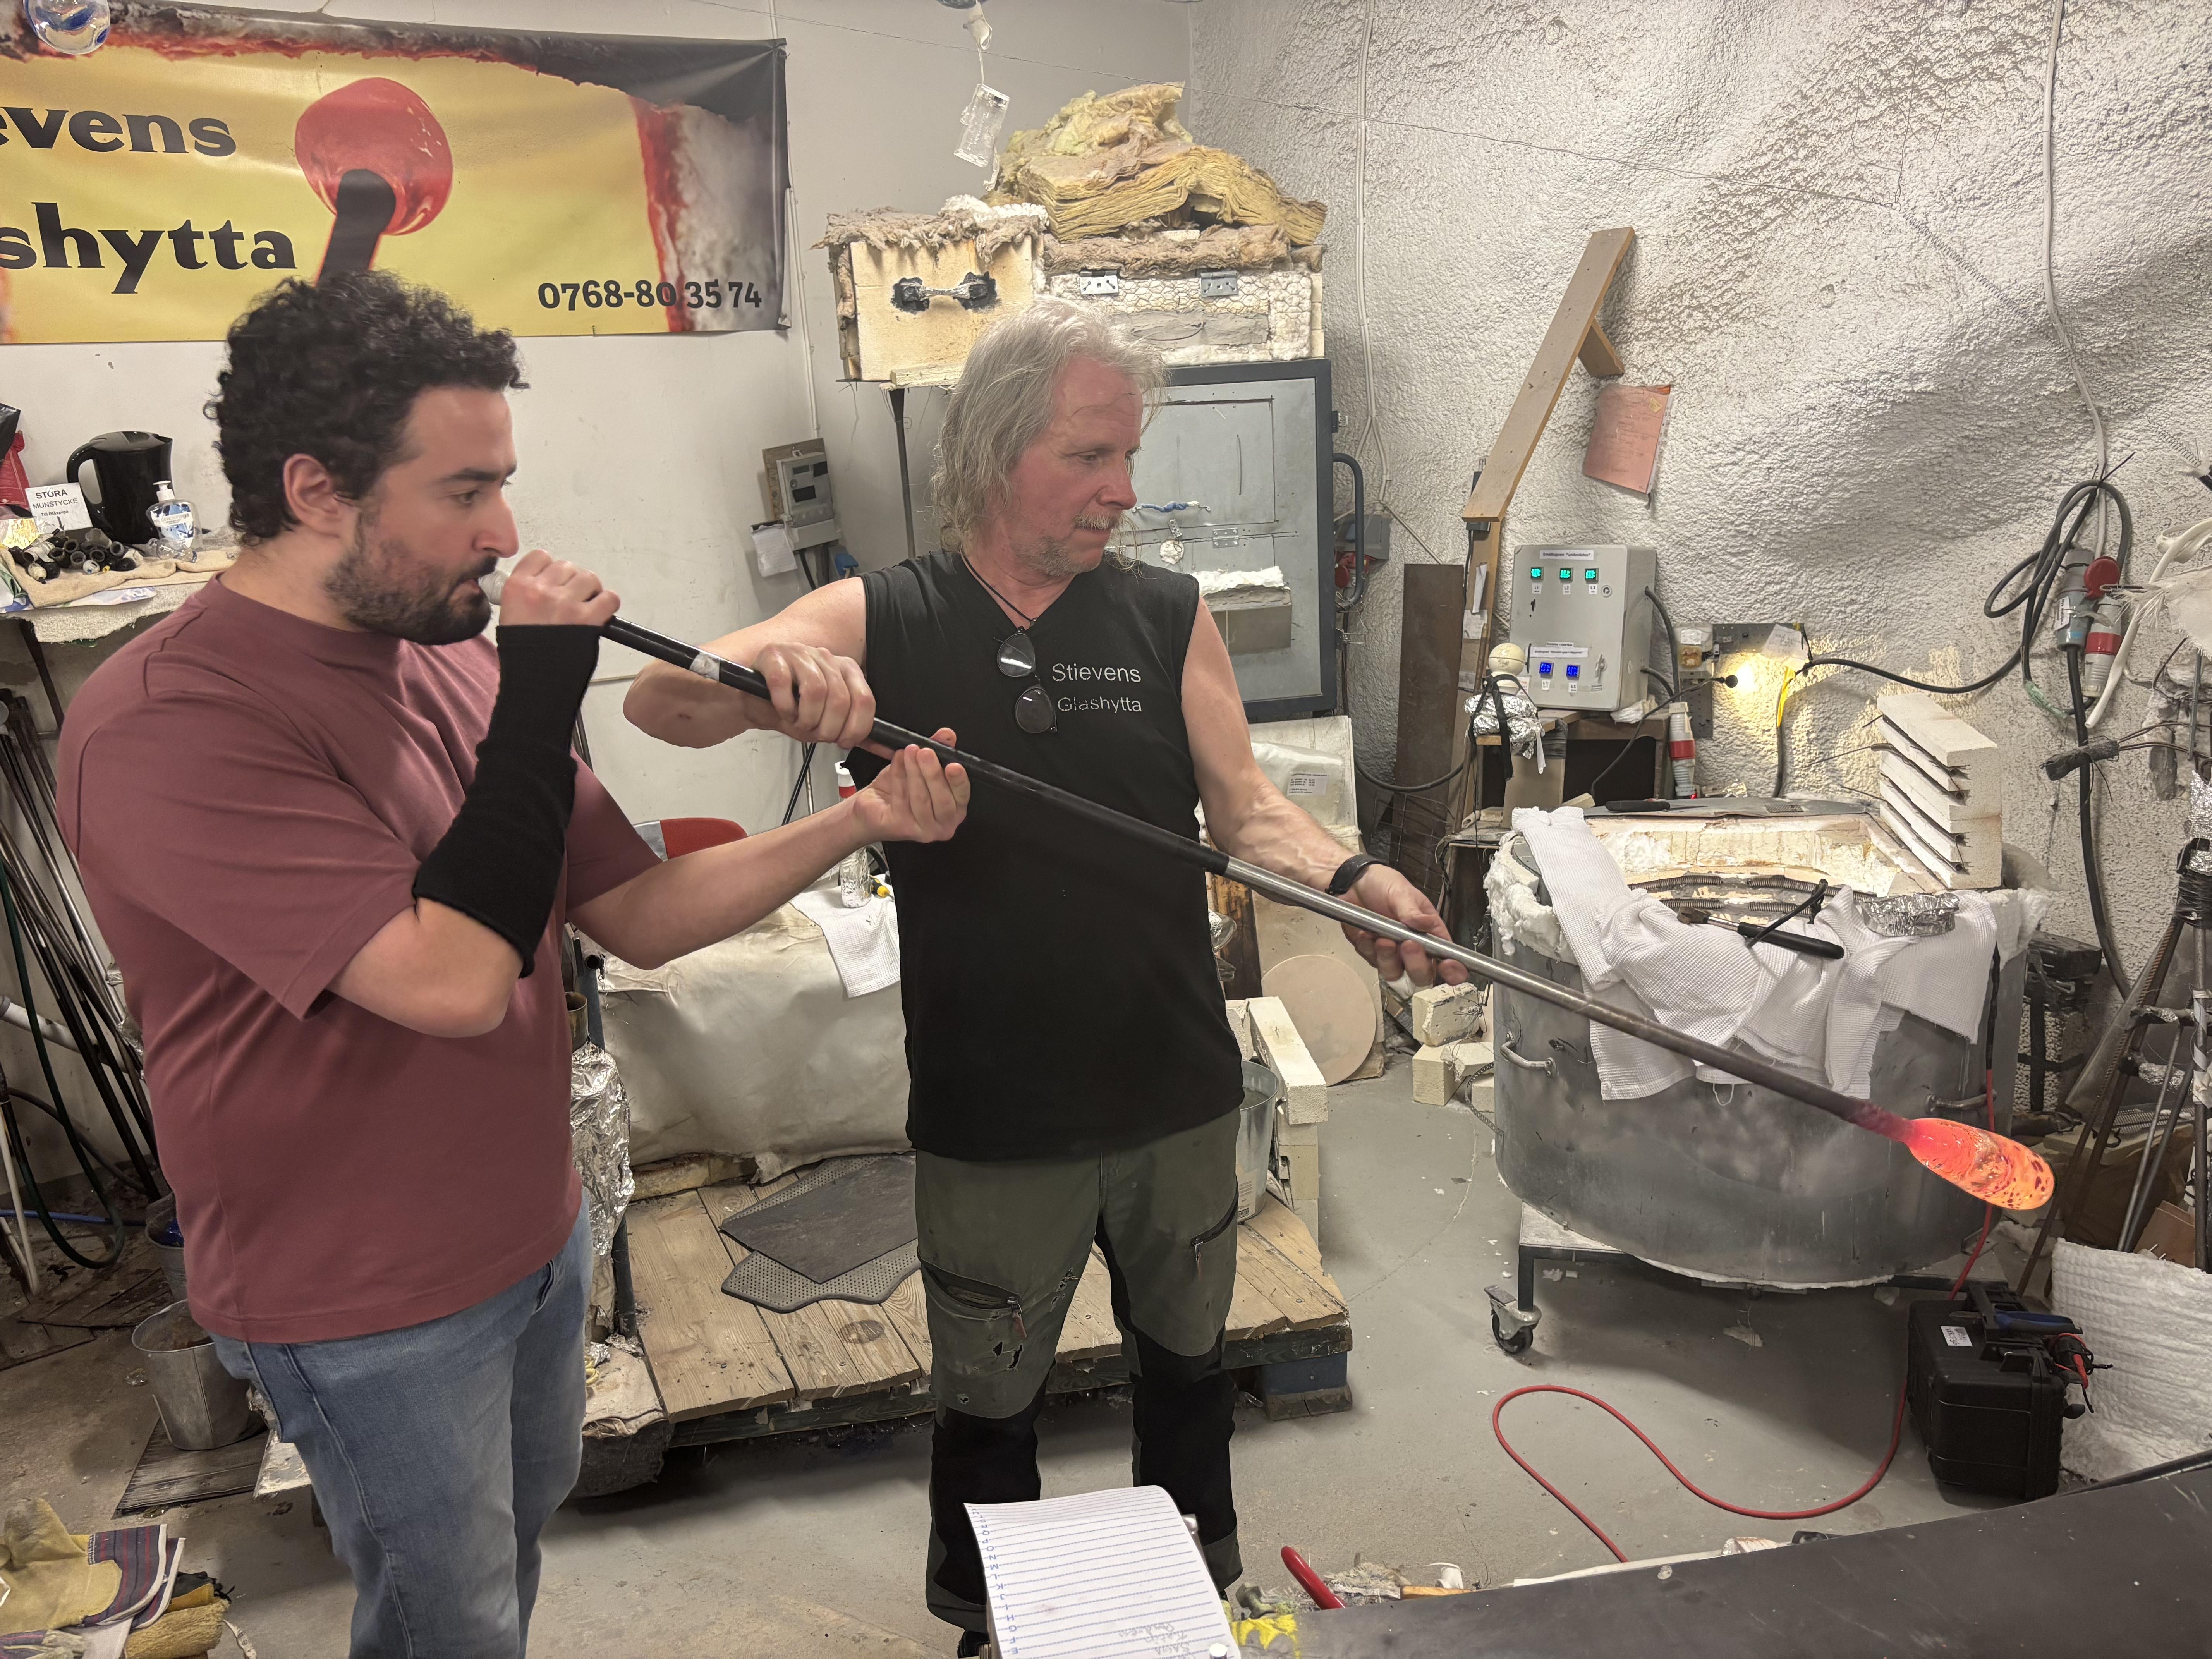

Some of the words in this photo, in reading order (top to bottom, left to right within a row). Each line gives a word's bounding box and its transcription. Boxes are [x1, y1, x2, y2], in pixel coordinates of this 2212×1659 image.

[0, 107, 236, 156] vens
[0, 202, 297, 294] shytta
[538, 280, 677, 311] 0768-80
[685, 279, 722, 308] 35
[728, 282, 762, 308] 74
[33, 498, 78, 509] MUNSTYCKE
[36, 489, 68, 499] STORA
[1052, 663, 1141, 682] Stievens
[1058, 696, 1142, 713] Glashytta
